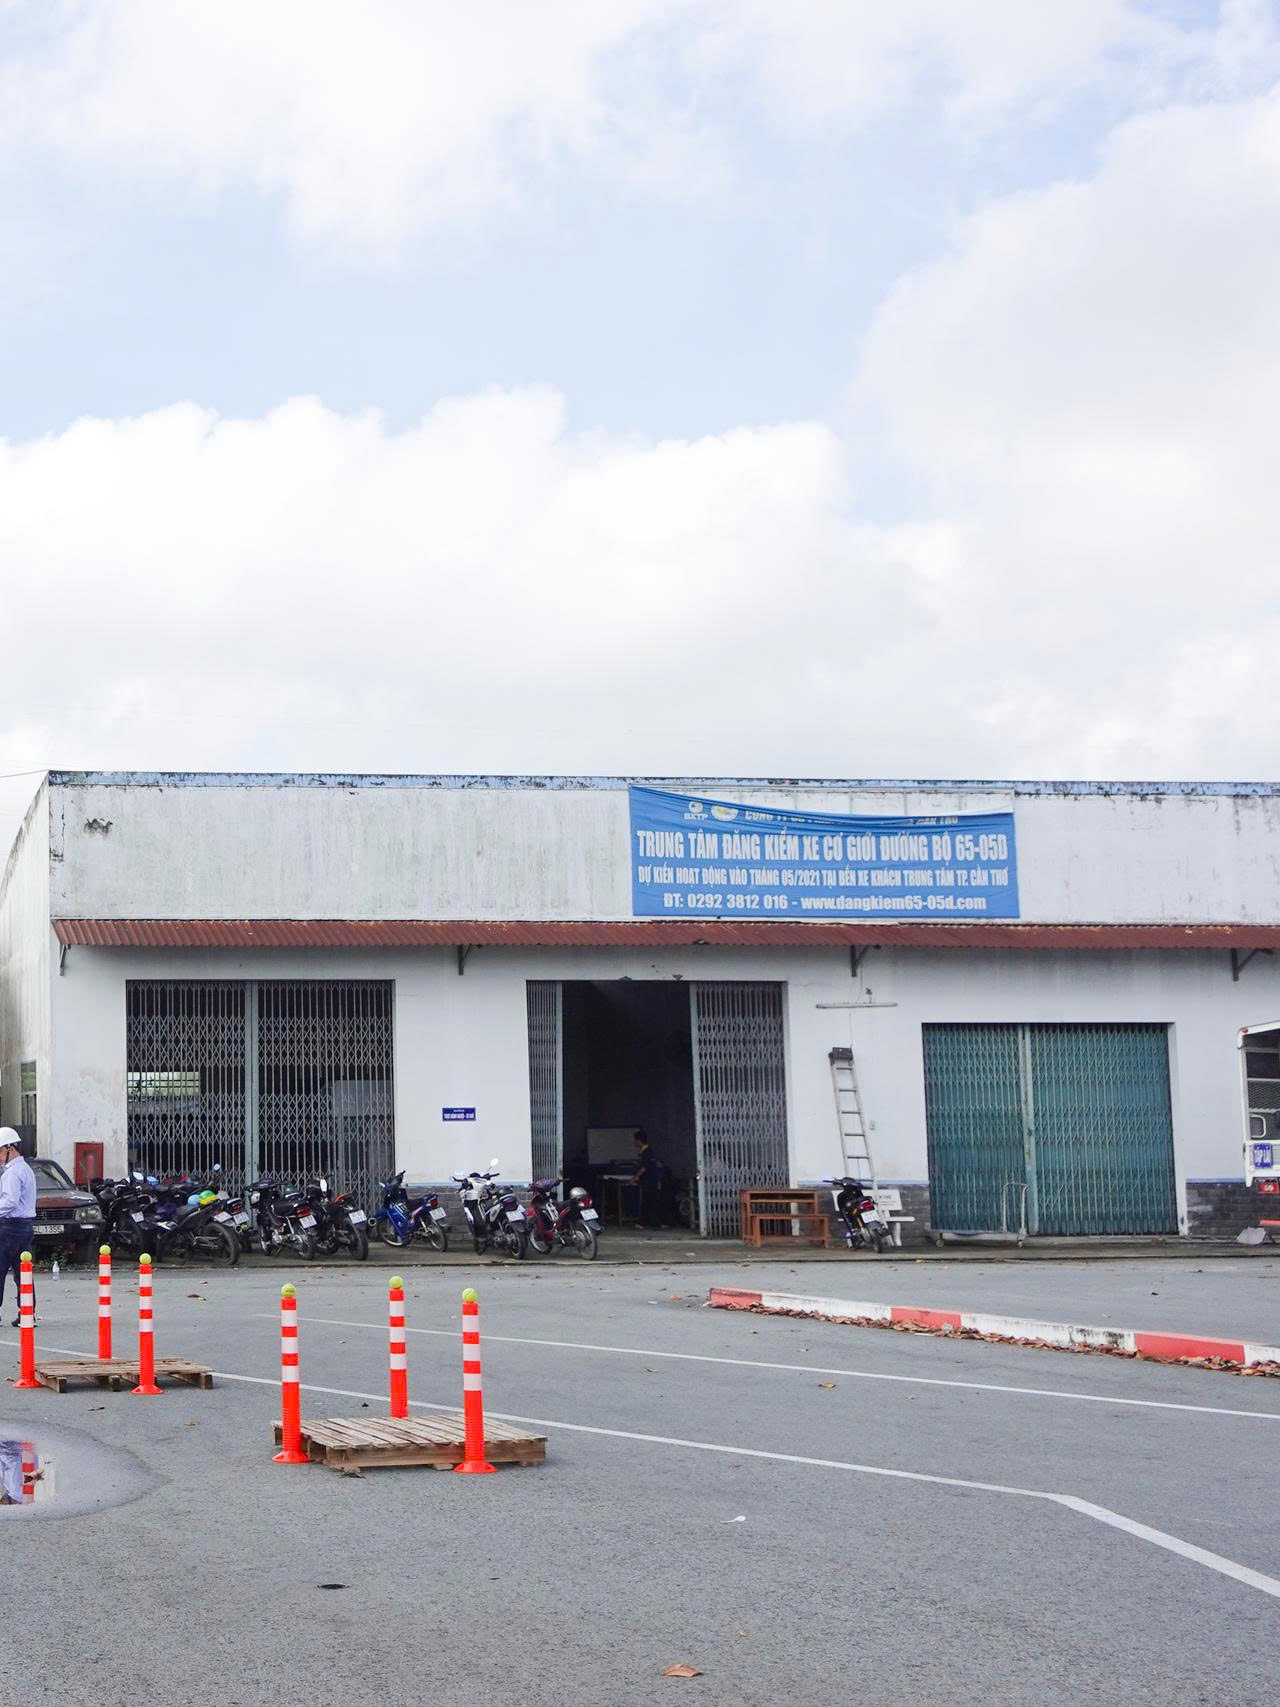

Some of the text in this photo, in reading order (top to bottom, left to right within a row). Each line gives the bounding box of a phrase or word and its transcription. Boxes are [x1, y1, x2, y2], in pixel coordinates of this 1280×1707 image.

[637, 826, 1008, 865] TRUNG TÂM ĐĂNG KIỂM XE CƠ GIỚI ĐƯỜNG BỘ 65-05D
[638, 862, 1008, 888] DỰ KIẾN HOẠT ĐỘNG VÀO THÁNG 05/2021 TẠI BẾN XE KHÁCH TRUNG TÂM TP. CẦN THƠ
[663, 893, 684, 907] ĐT:
[687, 893, 722, 908] 0292
[727, 894, 759, 908] 3812
[764, 895, 788, 909] 016
[801, 895, 987, 911] www.dangkiem65-05d.com
